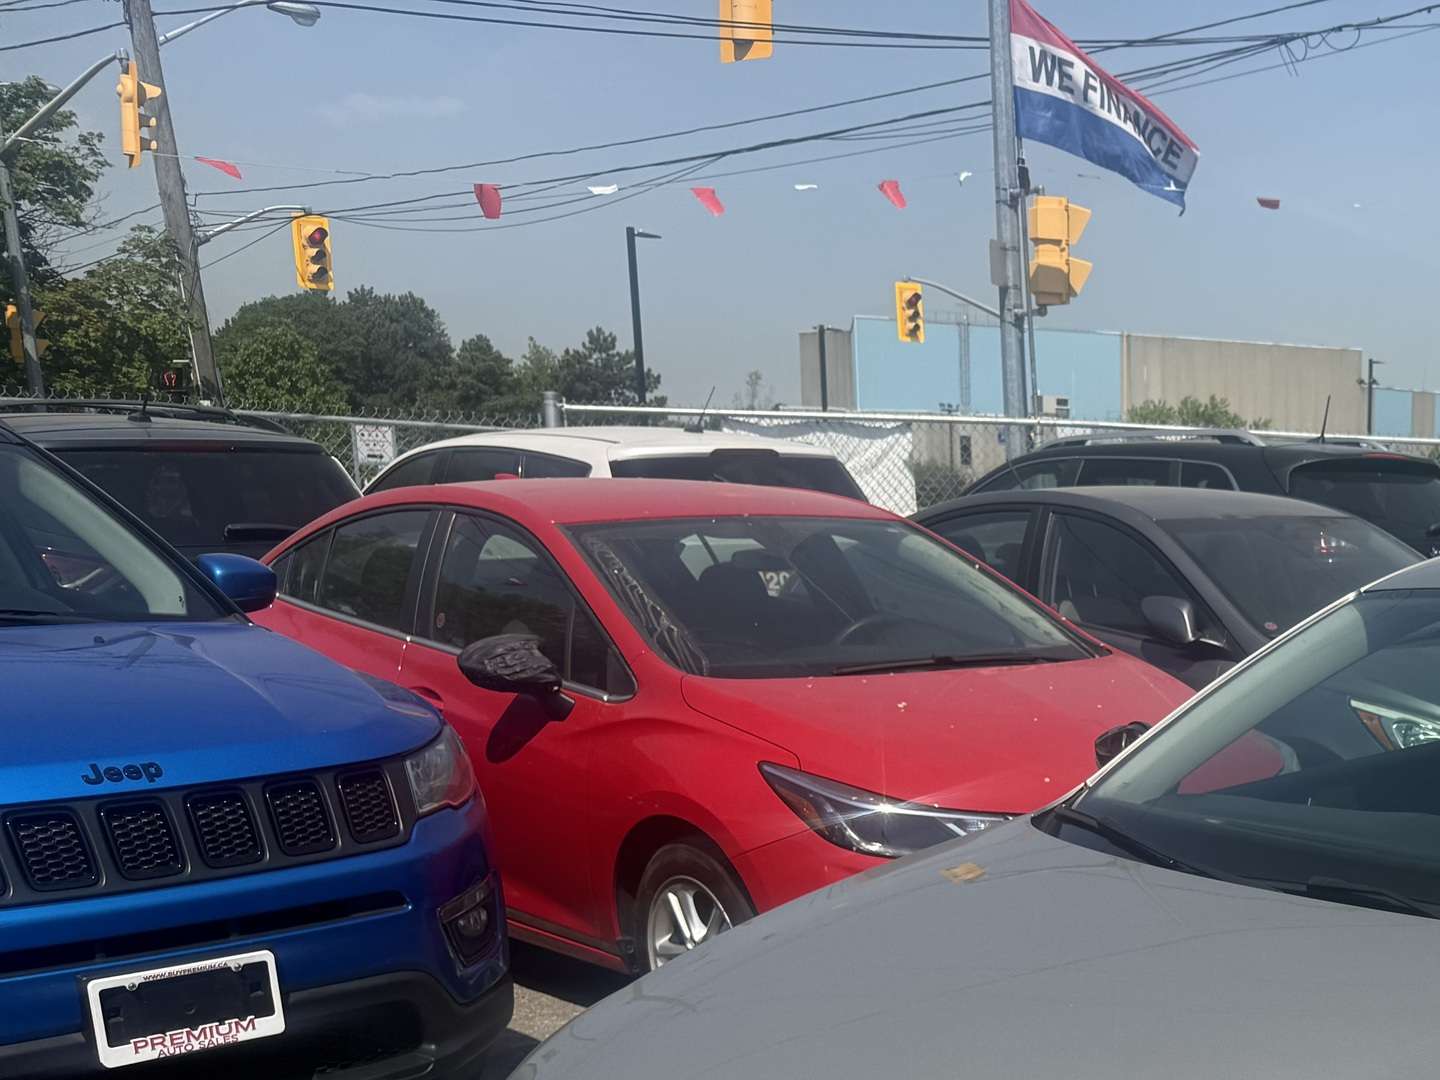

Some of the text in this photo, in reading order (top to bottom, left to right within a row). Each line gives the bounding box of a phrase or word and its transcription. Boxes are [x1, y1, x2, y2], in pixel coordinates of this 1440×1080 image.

[1028, 46, 1184, 170] WE FINANCE
[81, 762, 163, 785] Jeep
[132, 1017, 257, 1054] PREMIUM
[158, 1034, 239, 1058] AUTO SALES
